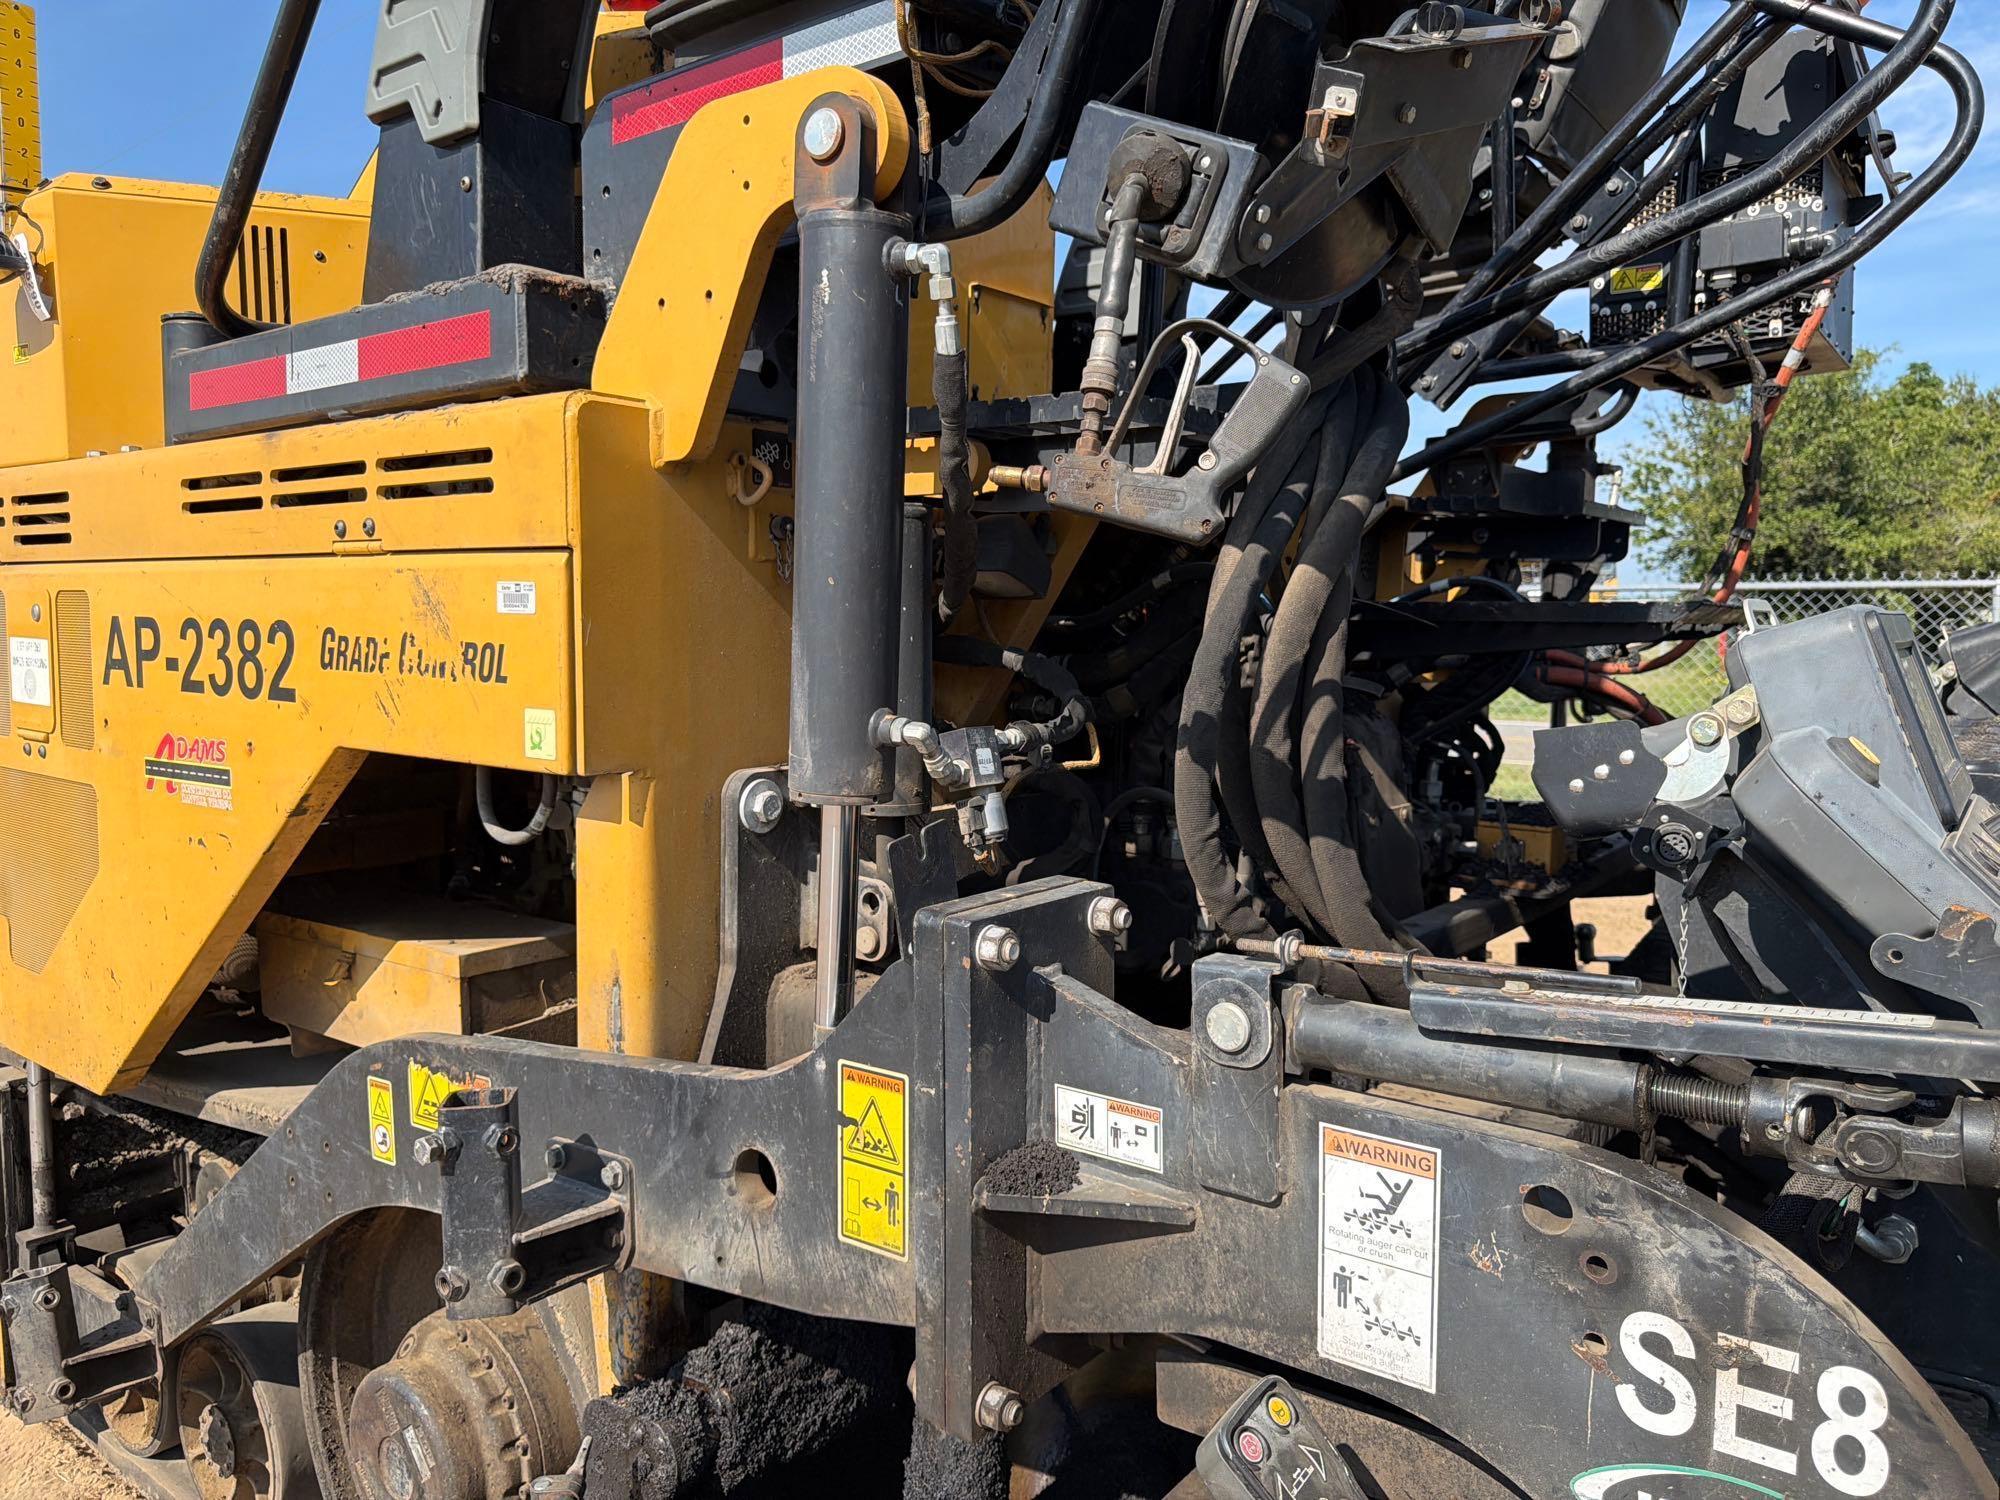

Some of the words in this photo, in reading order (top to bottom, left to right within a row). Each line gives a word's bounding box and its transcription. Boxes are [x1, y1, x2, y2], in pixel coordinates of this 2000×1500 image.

[13, 28, 21, 39] 6
[15, 58, 22, 69] 4
[16, 88, 24, 98] 2
[18, 117, 25, 128] 0
[17, 147, 28, 159] -2
[103, 616, 297, 703] AP-2382
[856, 1073, 901, 1093] WARNING
[1115, 1103, 1160, 1121] WARNING
[1344, 1138, 1432, 1173] WARNING
[1328, 1226, 1365, 1244] Rotating
[1367, 1237, 1393, 1250] auger
[1395, 1245, 1412, 1256] can
[1414, 1250, 1428, 1260] cut
[1357, 1245, 1367, 1253] or
[1614, 1311, 1890, 1497] SE8
